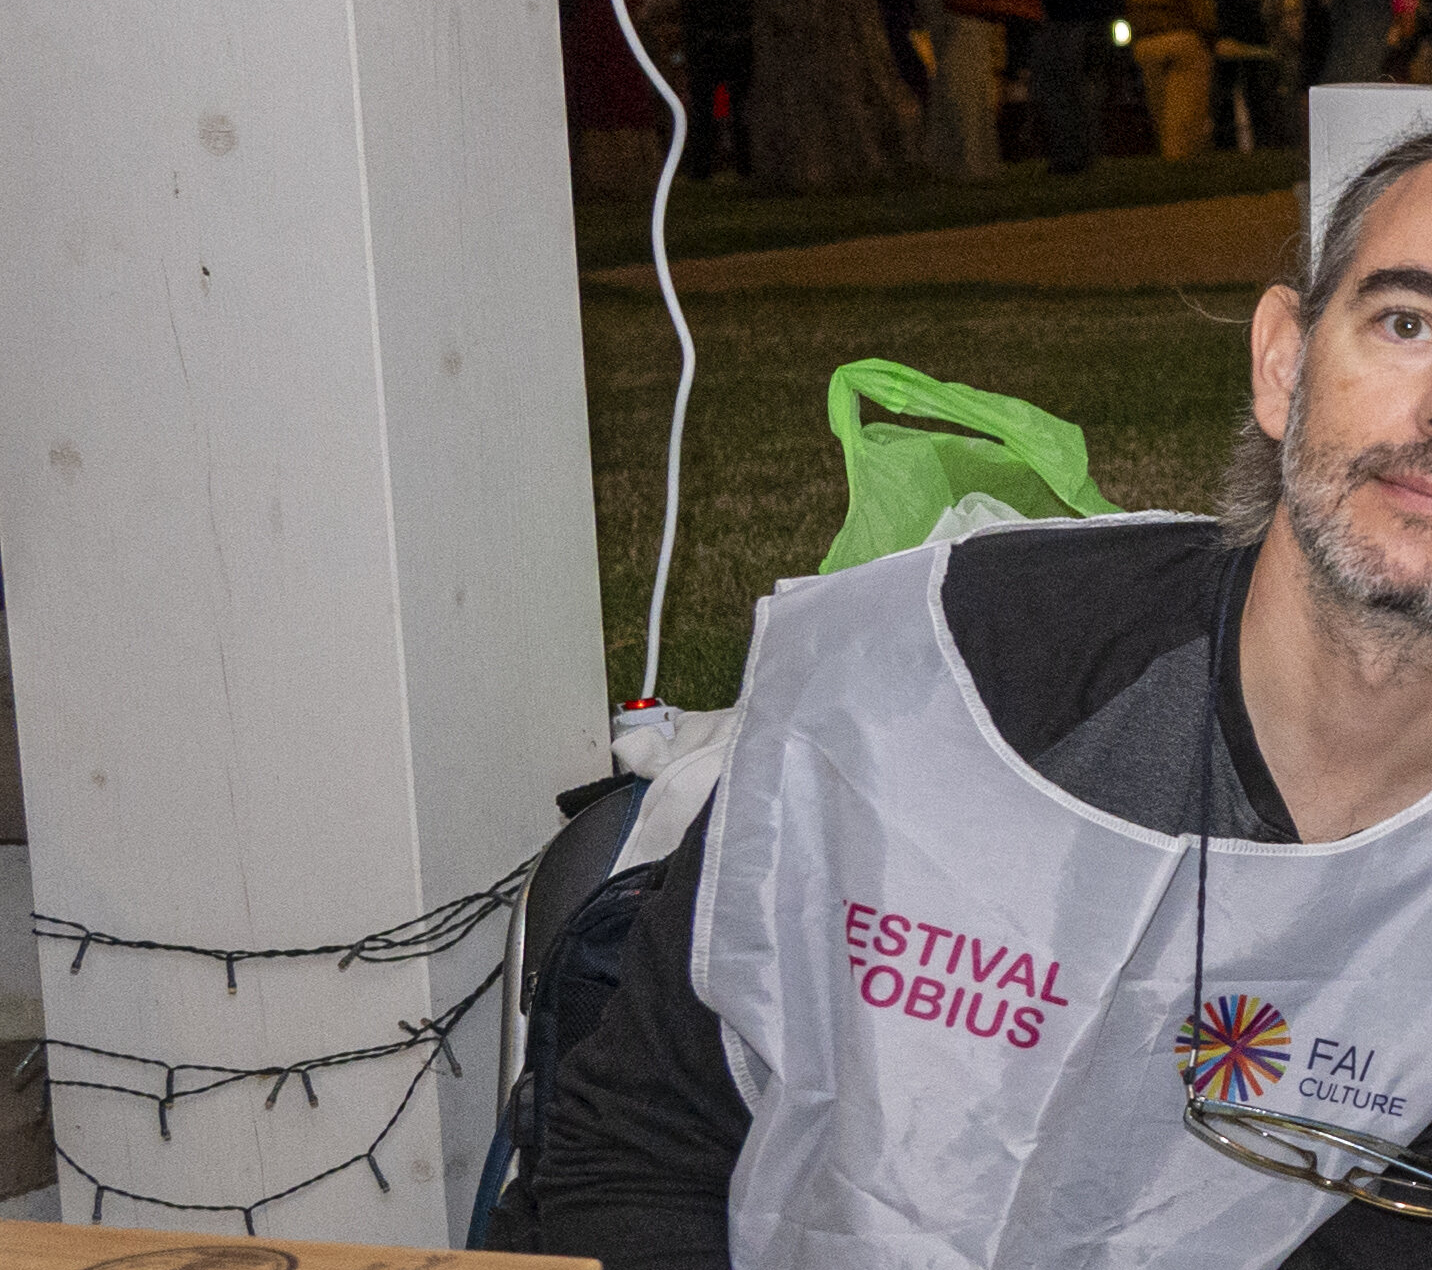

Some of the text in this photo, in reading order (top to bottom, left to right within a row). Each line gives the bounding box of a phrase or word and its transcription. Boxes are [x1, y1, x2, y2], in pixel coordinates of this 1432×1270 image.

[843, 899, 1069, 1007] ESTIVAL
[1307, 1037, 1376, 1078] FAI
[1299, 1076, 1408, 1117] CULTURE
